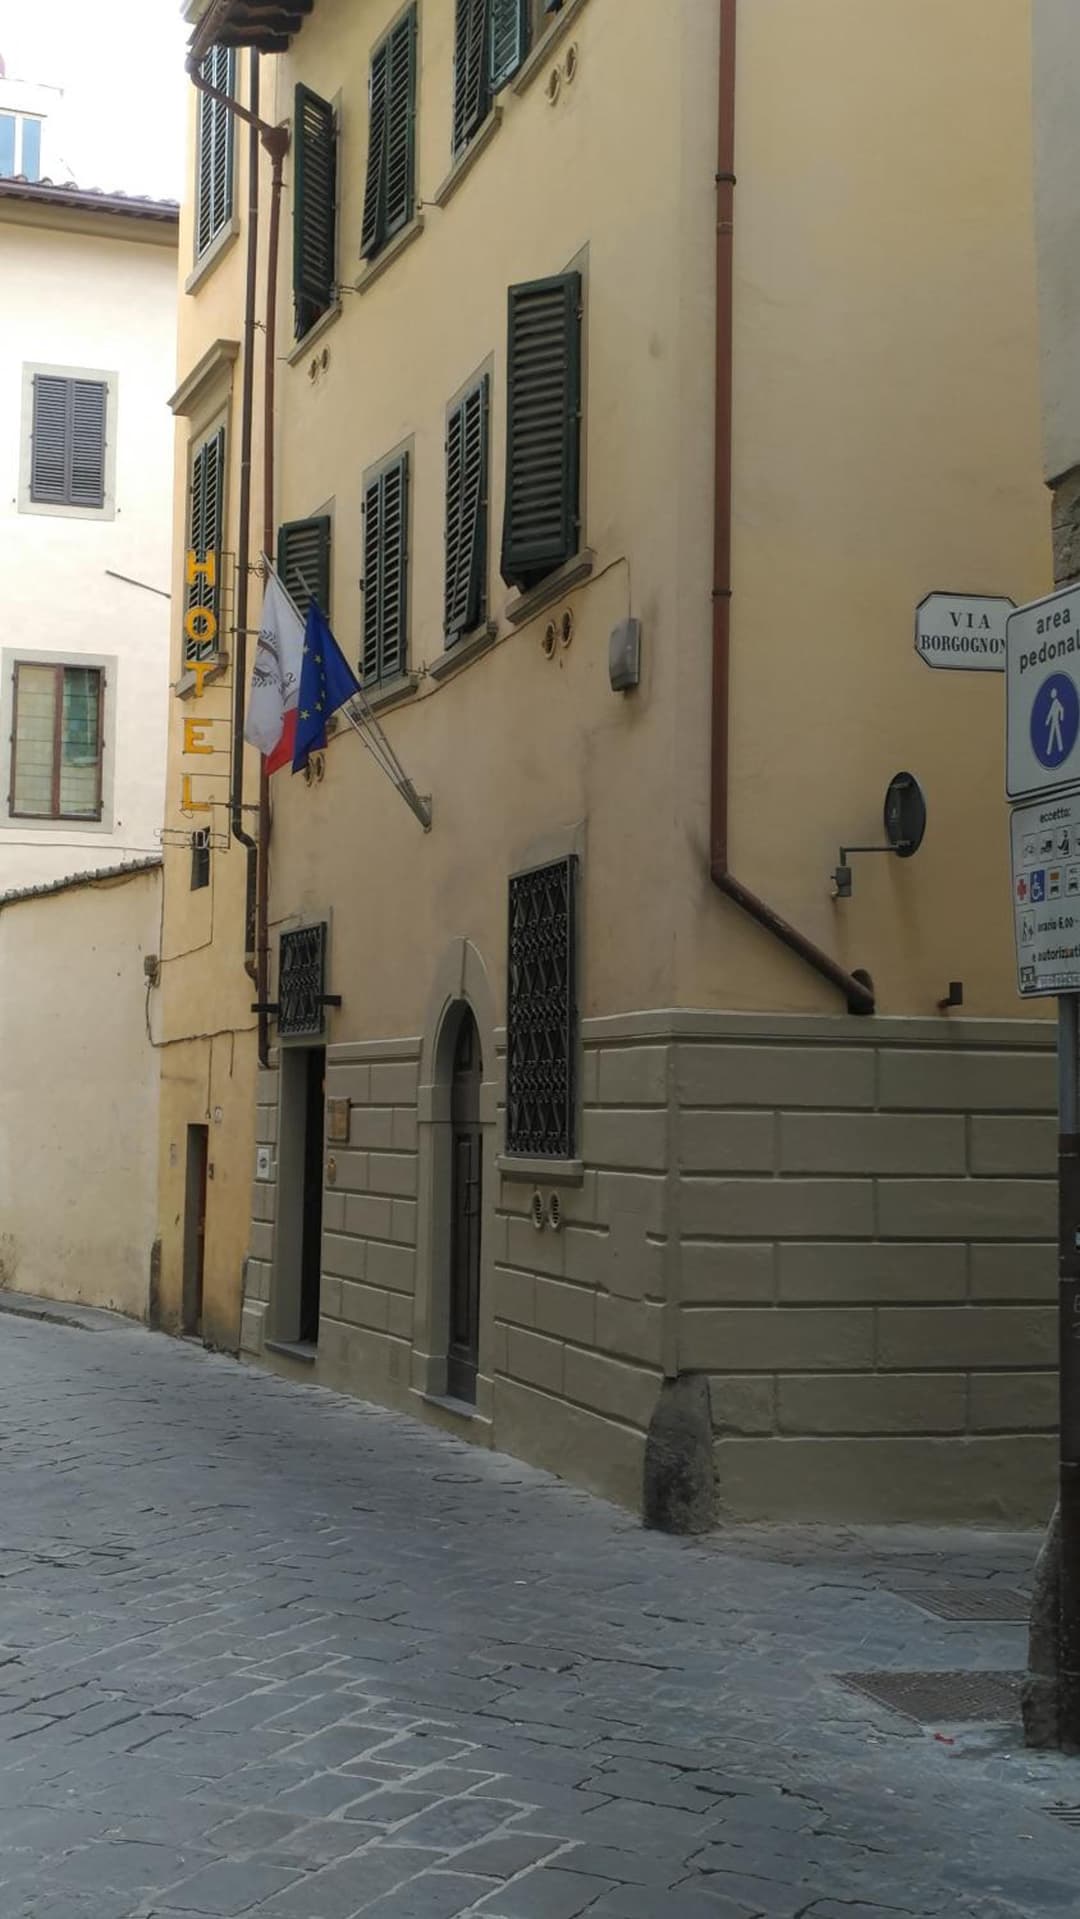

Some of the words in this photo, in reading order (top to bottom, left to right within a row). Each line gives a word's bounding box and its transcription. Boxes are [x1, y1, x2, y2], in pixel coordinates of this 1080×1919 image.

[949, 611, 991, 629] VIA
[1036, 607, 1072, 635] area
[182, 549, 217, 812] HOTEL
